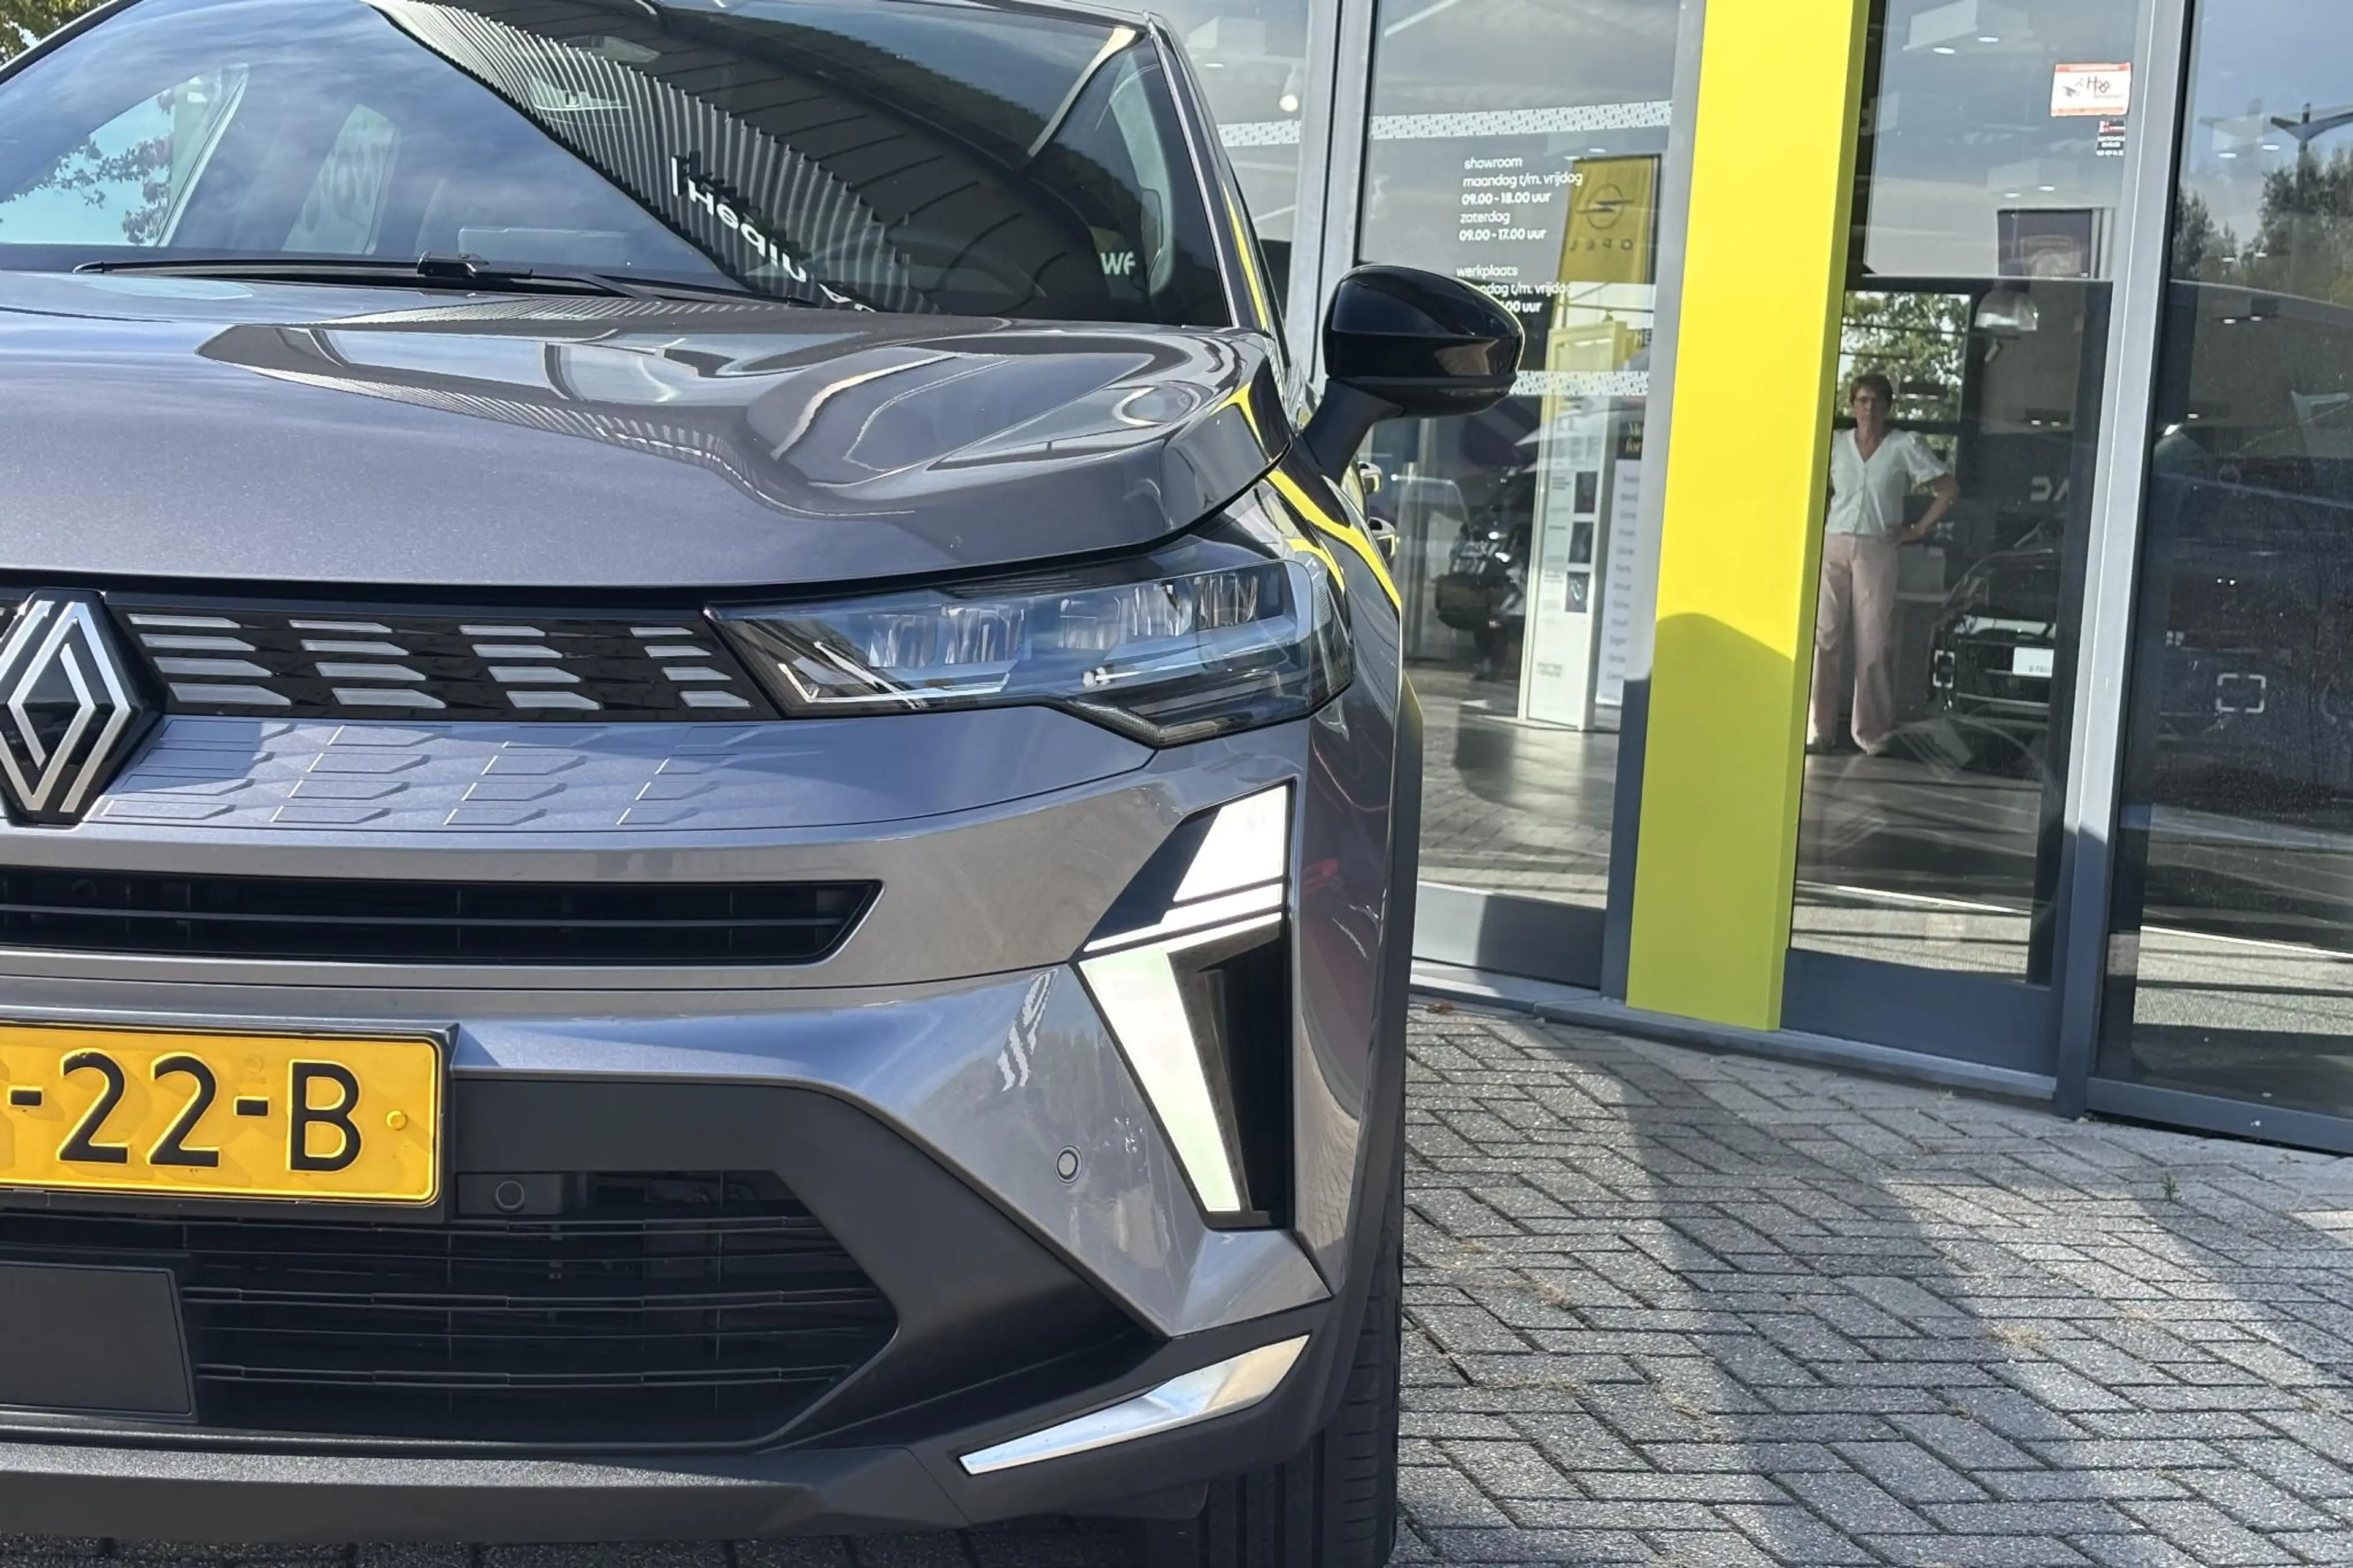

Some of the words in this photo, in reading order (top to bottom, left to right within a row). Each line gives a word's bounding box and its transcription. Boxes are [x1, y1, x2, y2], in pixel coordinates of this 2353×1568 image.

[1464, 157, 1523, 170] showroom
[1463, 174, 1517, 188] maandag
[1519, 173, 1542, 186] t/m.
[1543, 172, 1583, 186] vrijdag
[1461, 192, 1493, 205] 09.00
[1532, 192, 1552, 203] uur
[1459, 210, 1510, 225] zaterdag
[1459, 229, 1490, 241] 09.00
[1498, 228, 1525, 240] 17.00
[1527, 229, 1547, 240] uur
[1456, 264, 1518, 279] werkplaats
[1511, 281, 1533, 296] t/m.
[1522, 301, 1542, 313] uur
